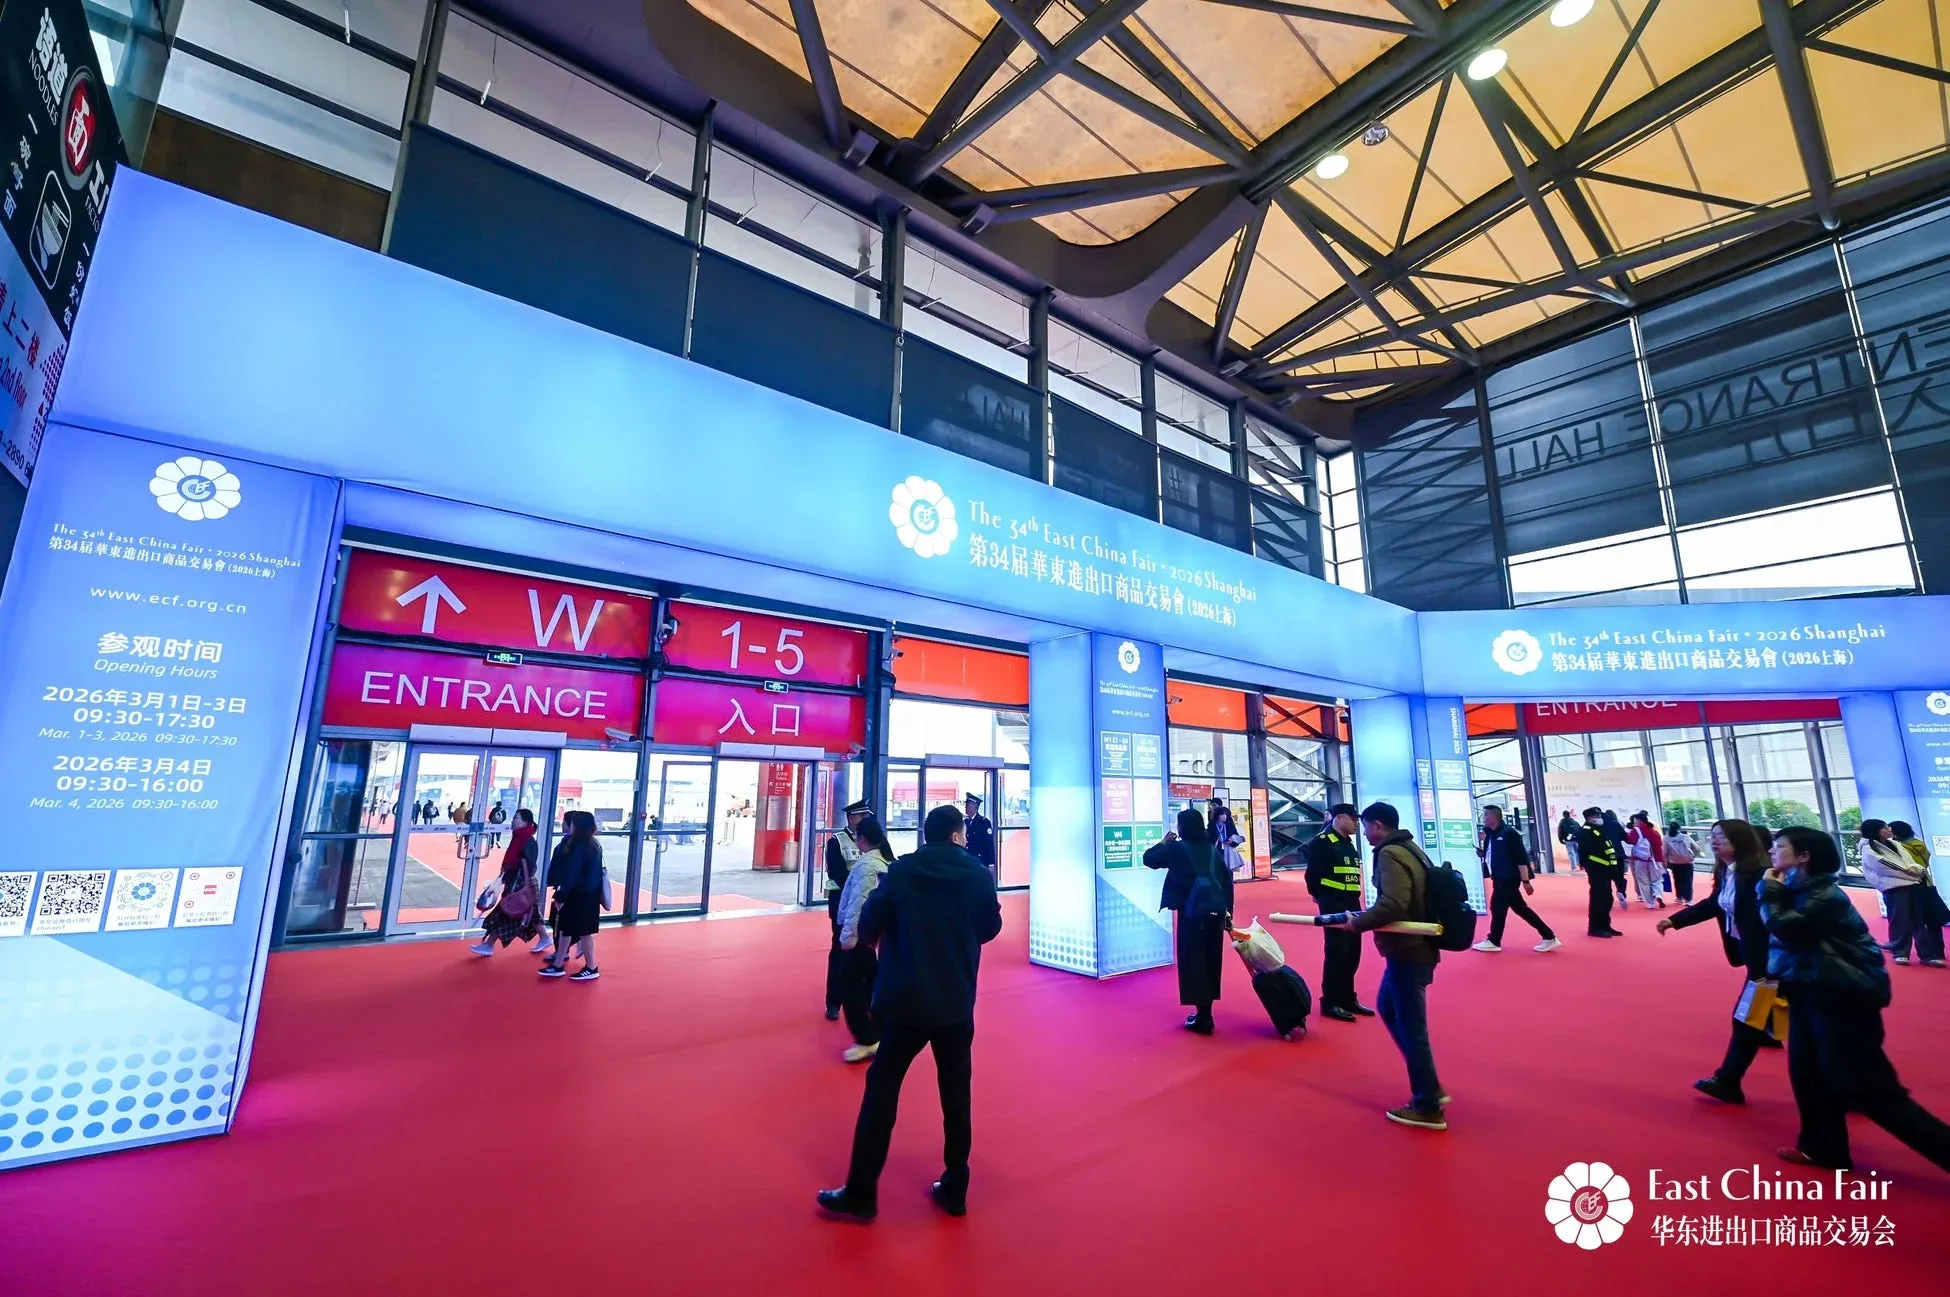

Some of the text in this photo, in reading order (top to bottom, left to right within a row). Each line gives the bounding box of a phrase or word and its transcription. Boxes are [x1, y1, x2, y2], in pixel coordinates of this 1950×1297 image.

[28, 48, 59, 126] NOODLES
[53, 523, 302, 568] The 34th East China Fair 2026 Shanghai
[968, 499, 1257, 604] The 34th East China Fair 2026 Shanghai
[90, 586, 248, 615] www.ecf.org.cn
[527, 588, 605, 651] W
[96, 631, 224, 664] 参观时间
[721, 620, 805, 675] 1-5
[1548, 622, 1886, 650] The 34th East China Fair 2026 Shanghai
[93, 658, 219, 680] Opening Hours
[42, 685, 248, 714] 2026年3月1日-3日
[361, 669, 608, 720] ENTRANCE
[73, 707, 216, 729] 09:30-17:30
[717, 696, 801, 737] 入口
[38, 727, 238, 746] Mar. 1-3, 2026 09:30-17:30
[53, 755, 213, 776] 2026年3月4日
[56, 775, 204, 793] 09:30-16:00
[29, 798, 219, 811] Mar. 4, 2026 09:30-16:00
